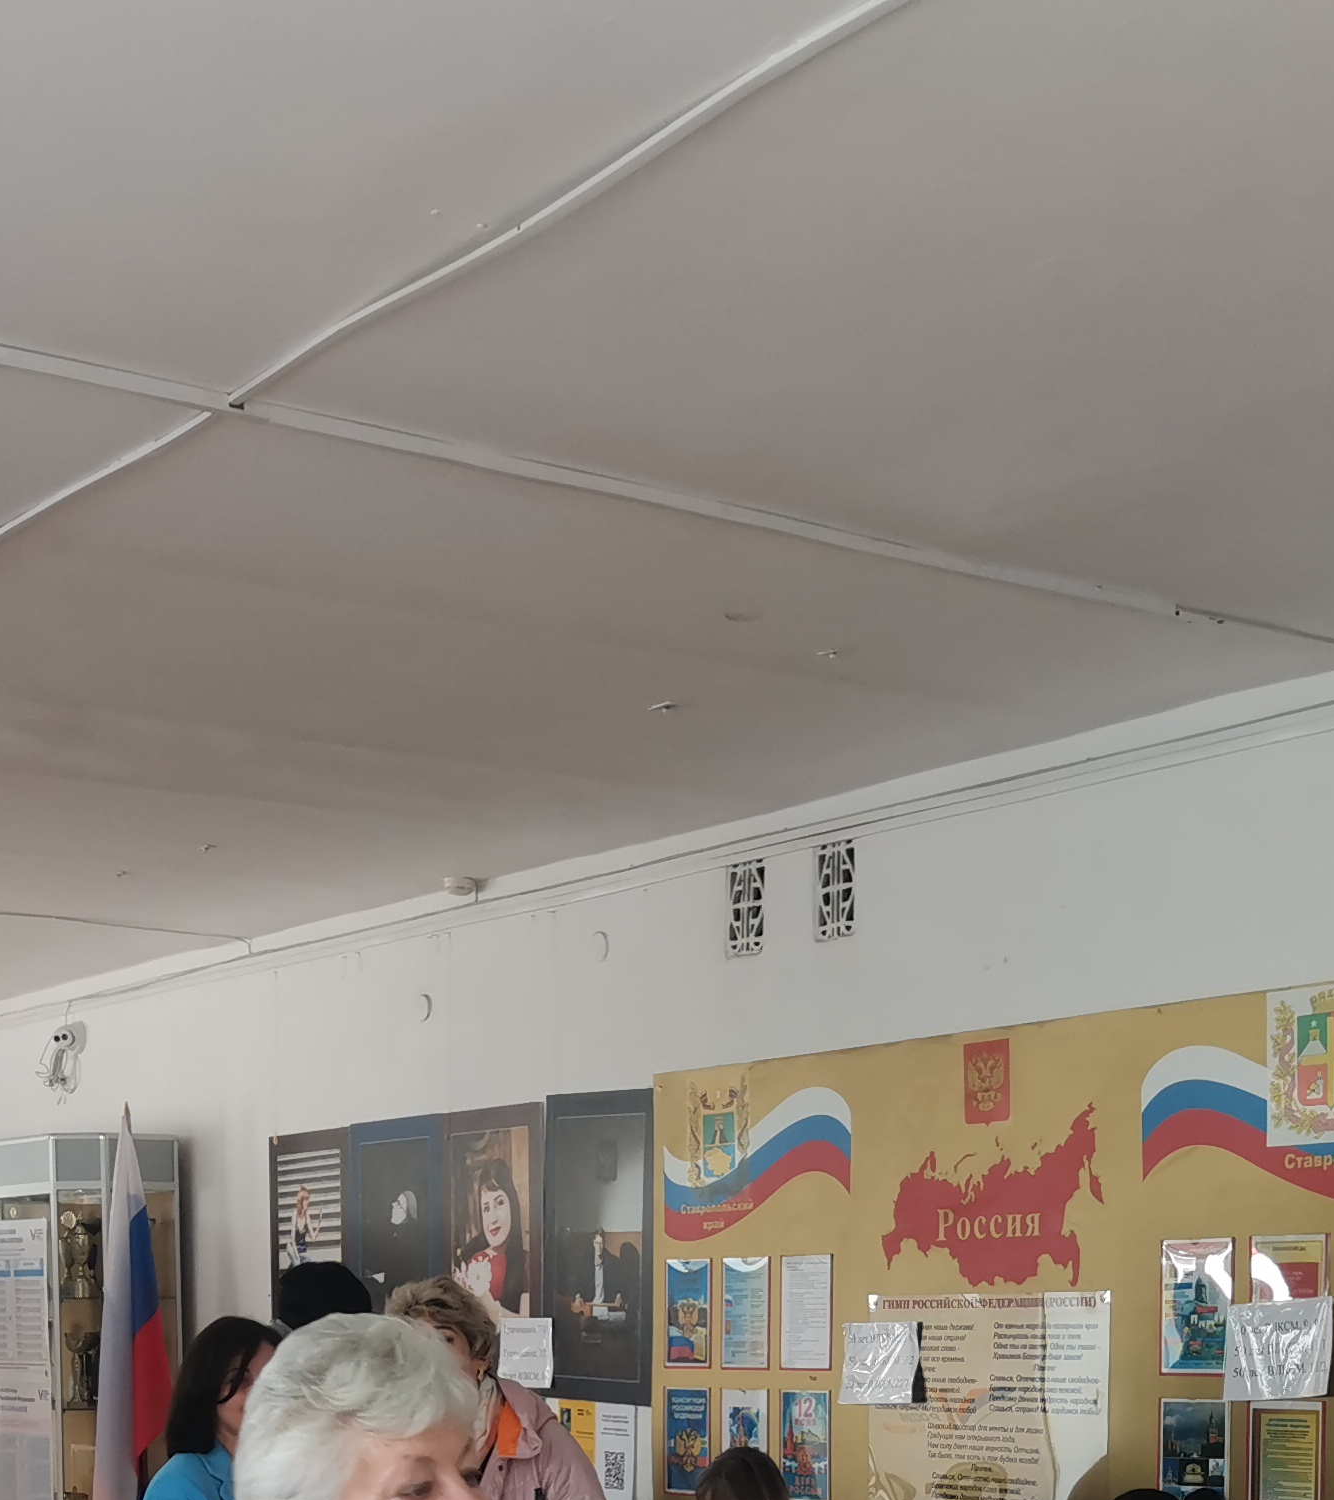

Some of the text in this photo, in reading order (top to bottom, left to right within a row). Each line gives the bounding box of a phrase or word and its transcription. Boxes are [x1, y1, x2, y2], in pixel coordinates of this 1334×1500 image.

[936, 1209, 1041, 1241] Россия
[882, 1299, 910, 1310] ГИМН
[912, 1297, 979, 1309] РОССИЙСКОЙ
[794, 1397, 813, 1418] 12
